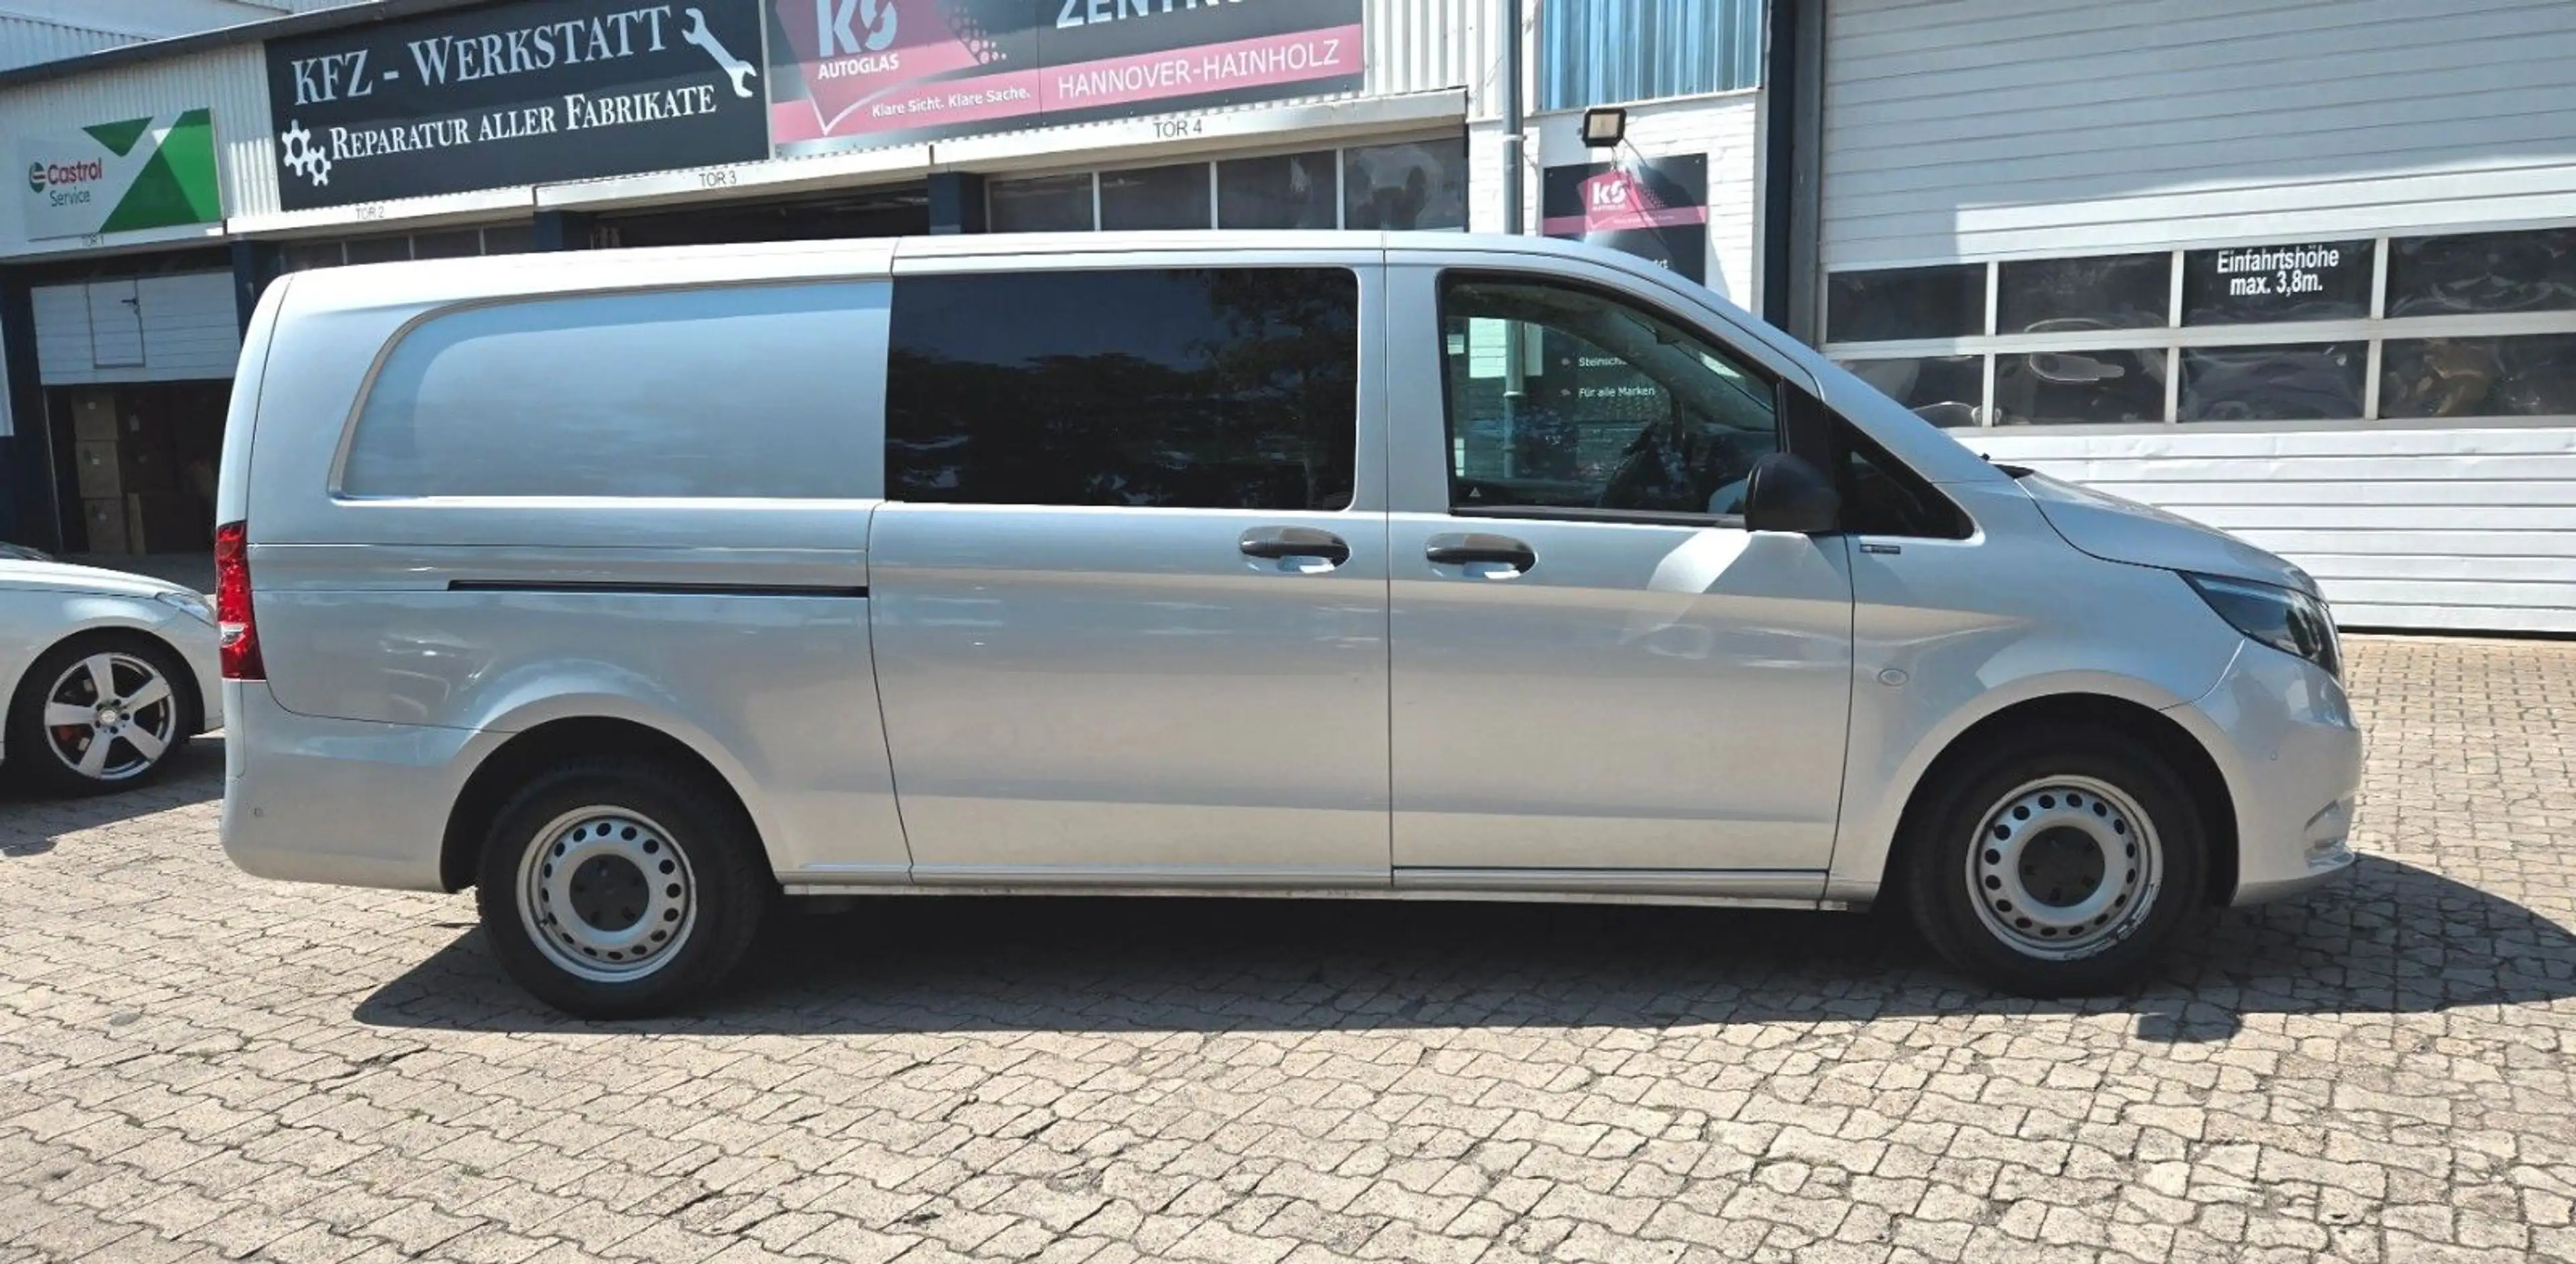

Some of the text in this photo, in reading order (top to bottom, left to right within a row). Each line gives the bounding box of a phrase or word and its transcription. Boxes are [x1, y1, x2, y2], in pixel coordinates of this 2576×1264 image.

[291, 49, 373, 106] KFZ
[407, 5, 671, 87] WERKSTATT
[818, 53, 900, 80] AUTOGLAS
[1057, 39, 1340, 99] HANNOVER-HAINHOLZ
[872, 86, 1031, 117] Klare Sicht. Klare Sache.
[329, 84, 717, 160] REPARATUR ALLER FABRIKATE
[1153, 120, 1203, 138] TOR 4
[48, 157, 102, 185] Castrol
[699, 170, 737, 187] TOR 3
[50, 187, 91, 207] Service
[1593, 180, 1627, 205] KS
[356, 205, 385, 220] TOR 2
[2217, 244, 2340, 274] Einfahrtshöhe
[2230, 270, 2323, 297] max. 3,8m.
[1578, 386, 1656, 399] Für alle Marken
